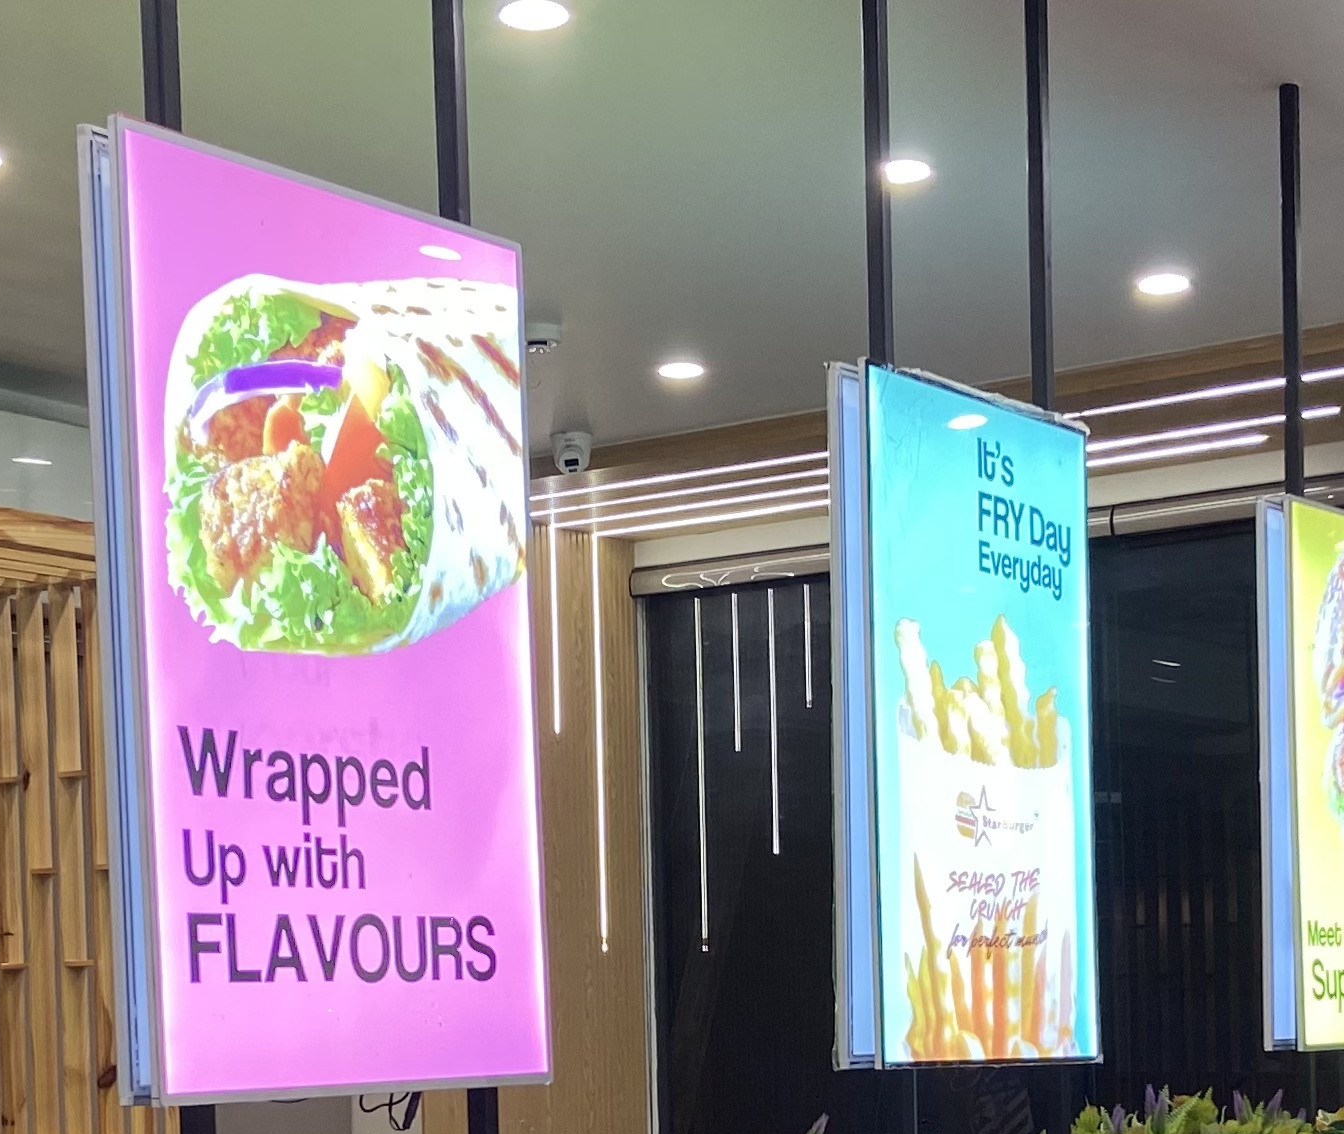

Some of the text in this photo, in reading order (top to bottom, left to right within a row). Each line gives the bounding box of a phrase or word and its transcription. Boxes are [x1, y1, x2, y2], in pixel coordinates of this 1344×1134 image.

[977, 437, 1014, 487] It's
[978, 490, 1071, 567] FRY Day
[978, 539, 1062, 601] Everyday
[177, 724, 432, 827] Wrapped
[182, 829, 366, 905] Up with
[946, 868, 1040, 900] SEALED THE
[970, 897, 1027, 921] CRUNCH
[1308, 920, 1342, 947] Meet
[187, 913, 497, 984] FLAVOURS
